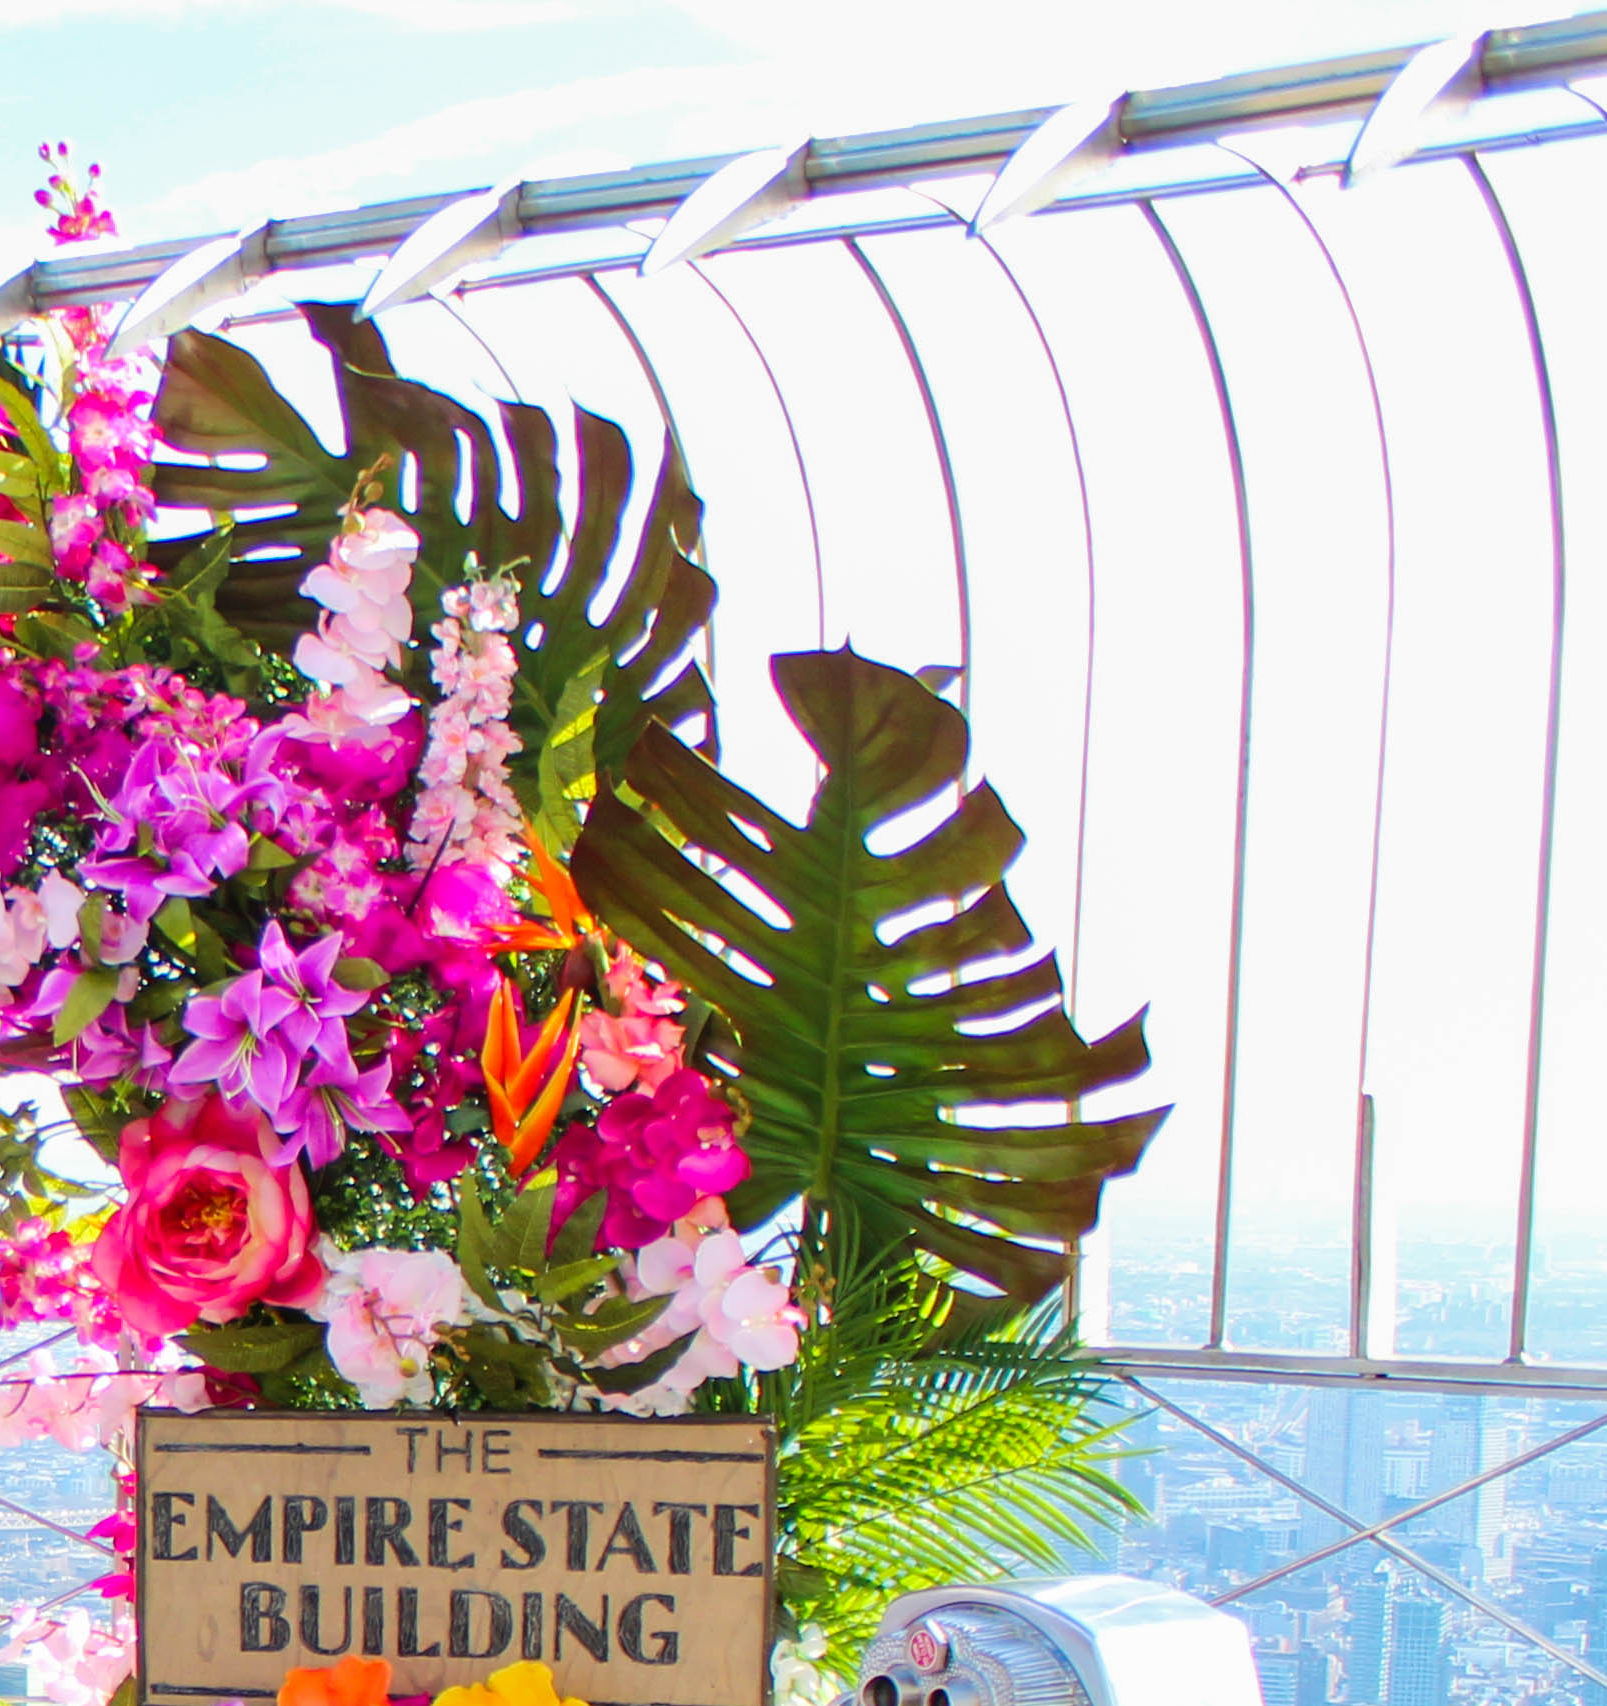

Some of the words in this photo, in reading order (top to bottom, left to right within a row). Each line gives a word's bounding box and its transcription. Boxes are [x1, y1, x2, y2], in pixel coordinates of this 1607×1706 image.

[396, 1426, 513, 1475] THE
[151, 1490, 476, 1570] EMPIRE
[500, 1498, 764, 1577] STATE
[239, 1580, 681, 1666] BUILDING
